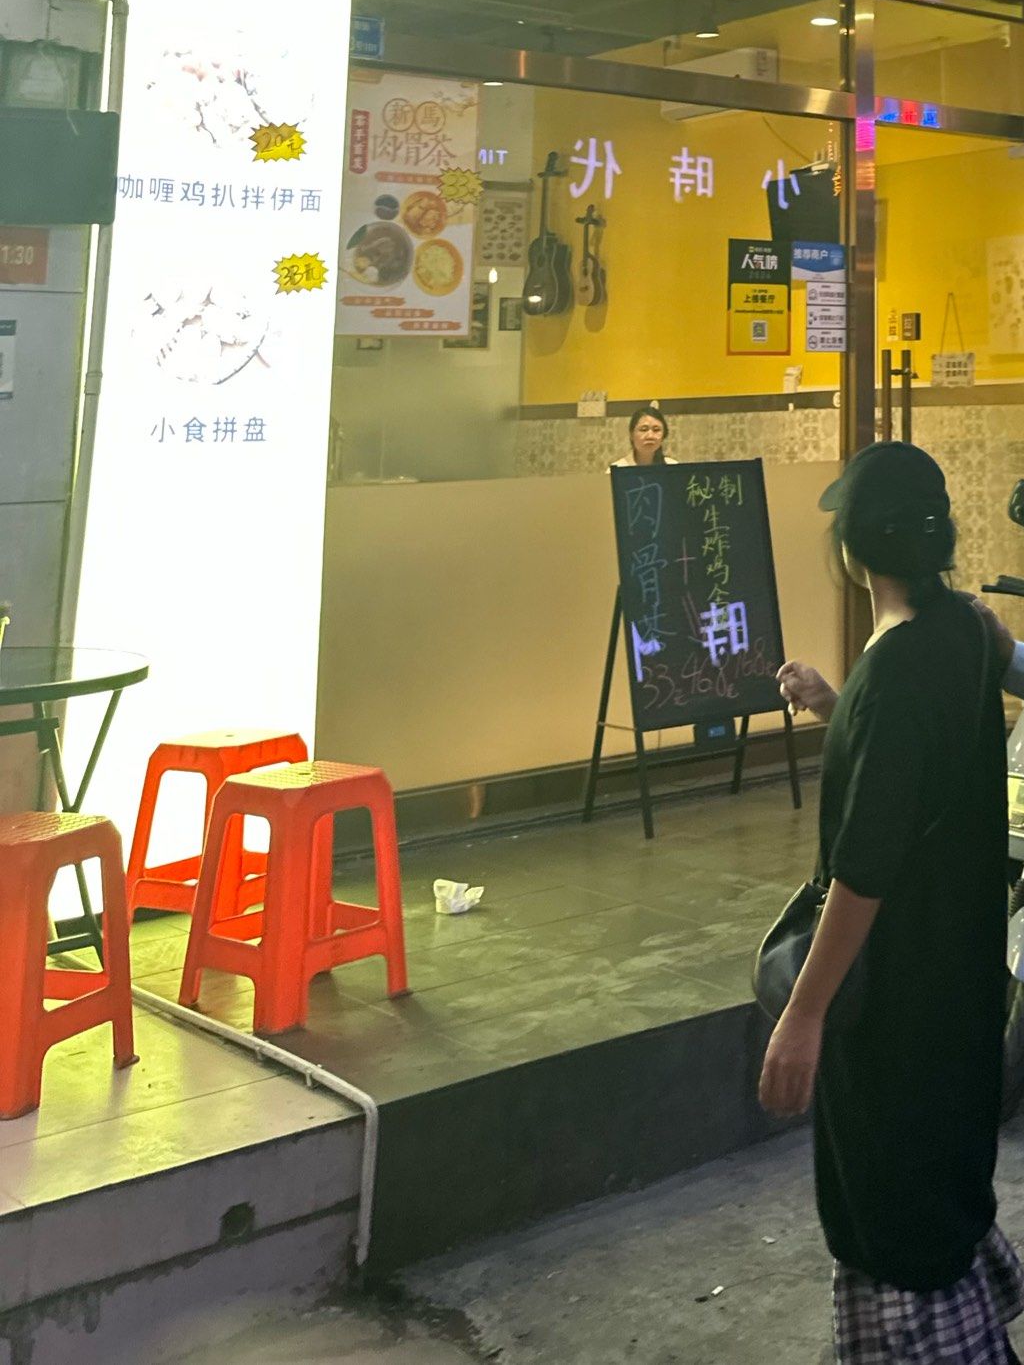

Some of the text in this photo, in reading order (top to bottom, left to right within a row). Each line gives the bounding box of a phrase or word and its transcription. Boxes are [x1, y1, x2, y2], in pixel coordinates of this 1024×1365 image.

[371, 129, 458, 167] 肉骨茶
[116, 174, 323, 213] 咖喱鸡扒拌伊面
[150, 416, 268, 443] 小食拼盘
